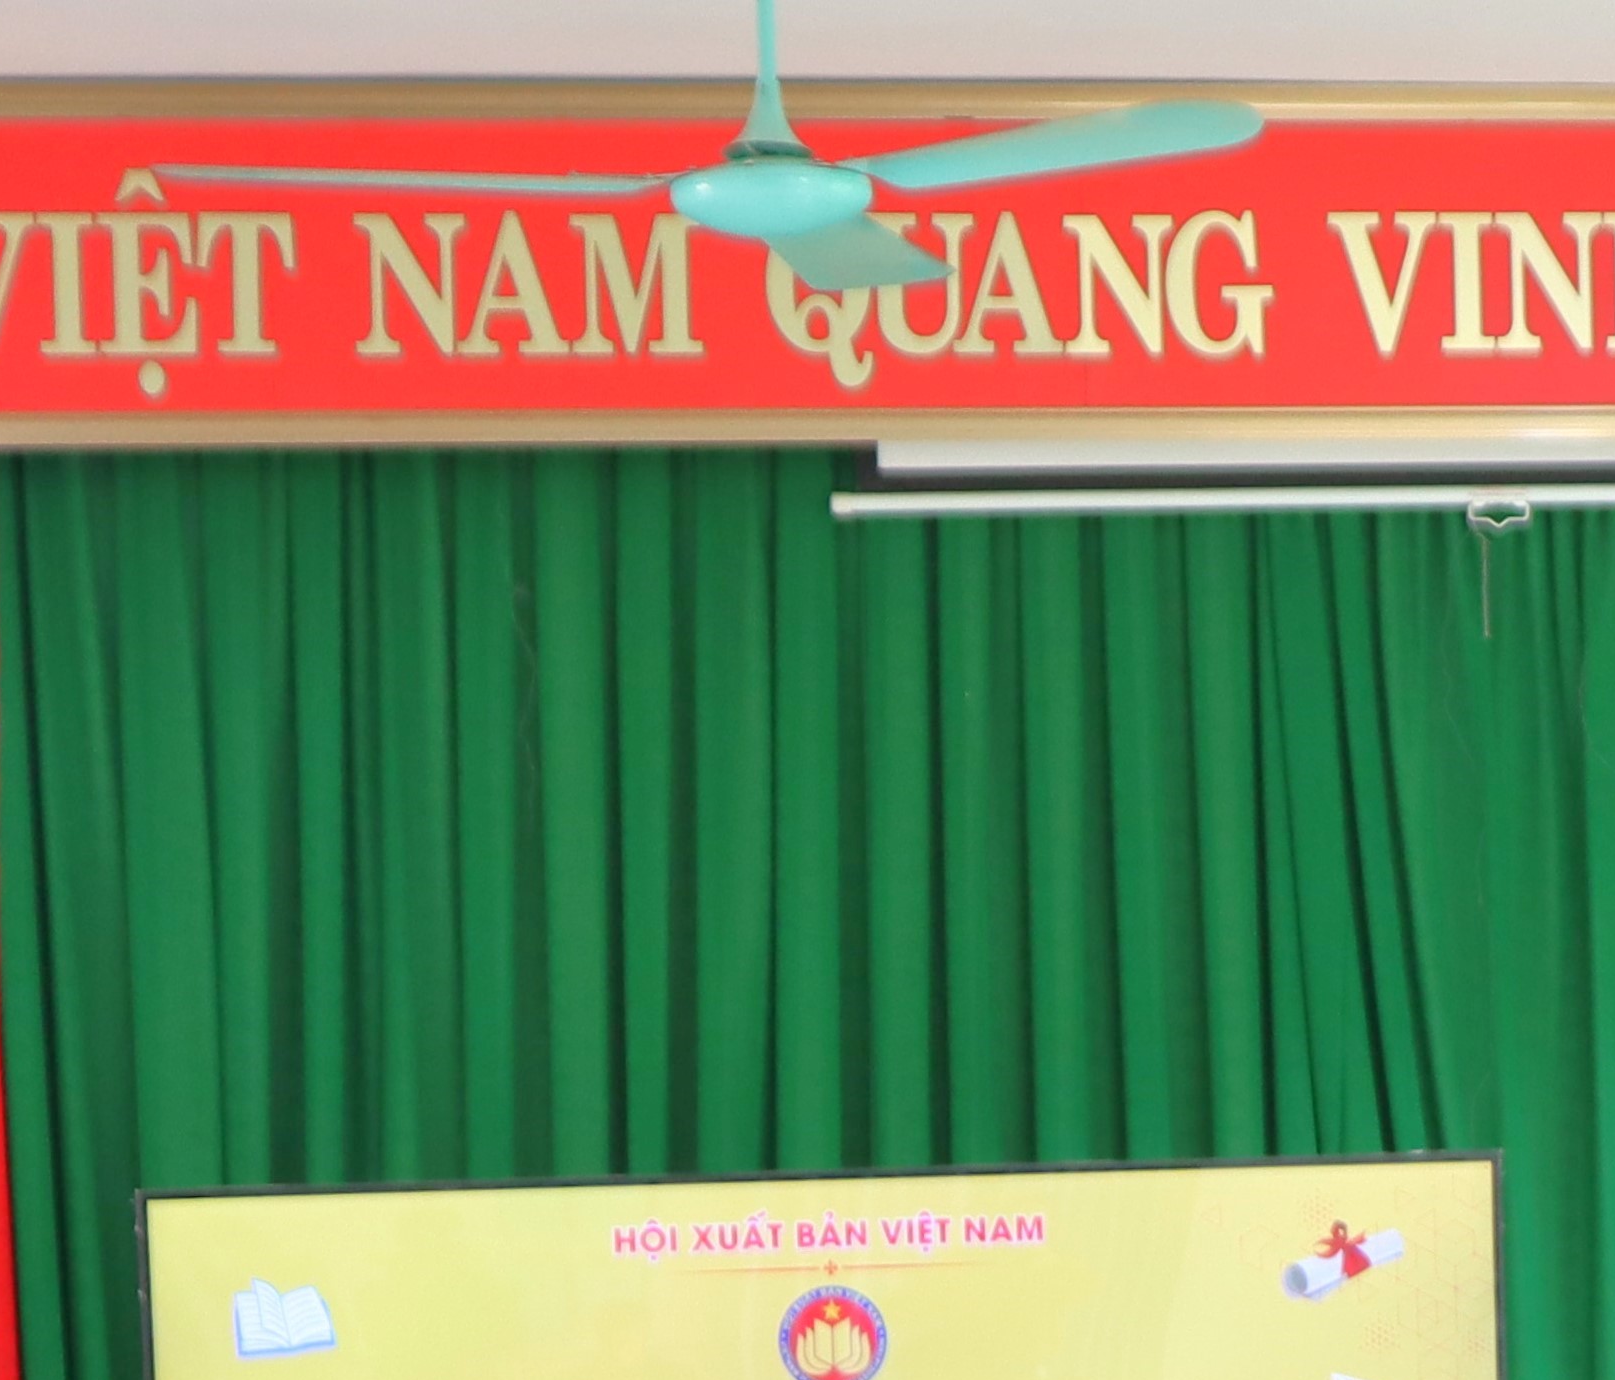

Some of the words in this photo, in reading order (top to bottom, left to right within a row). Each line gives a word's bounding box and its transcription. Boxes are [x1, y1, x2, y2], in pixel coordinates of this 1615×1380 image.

[352, 210, 705, 357] NAM
[765, 209, 1275, 387] QUANG
[964, 1216, 1045, 1244] NAM
